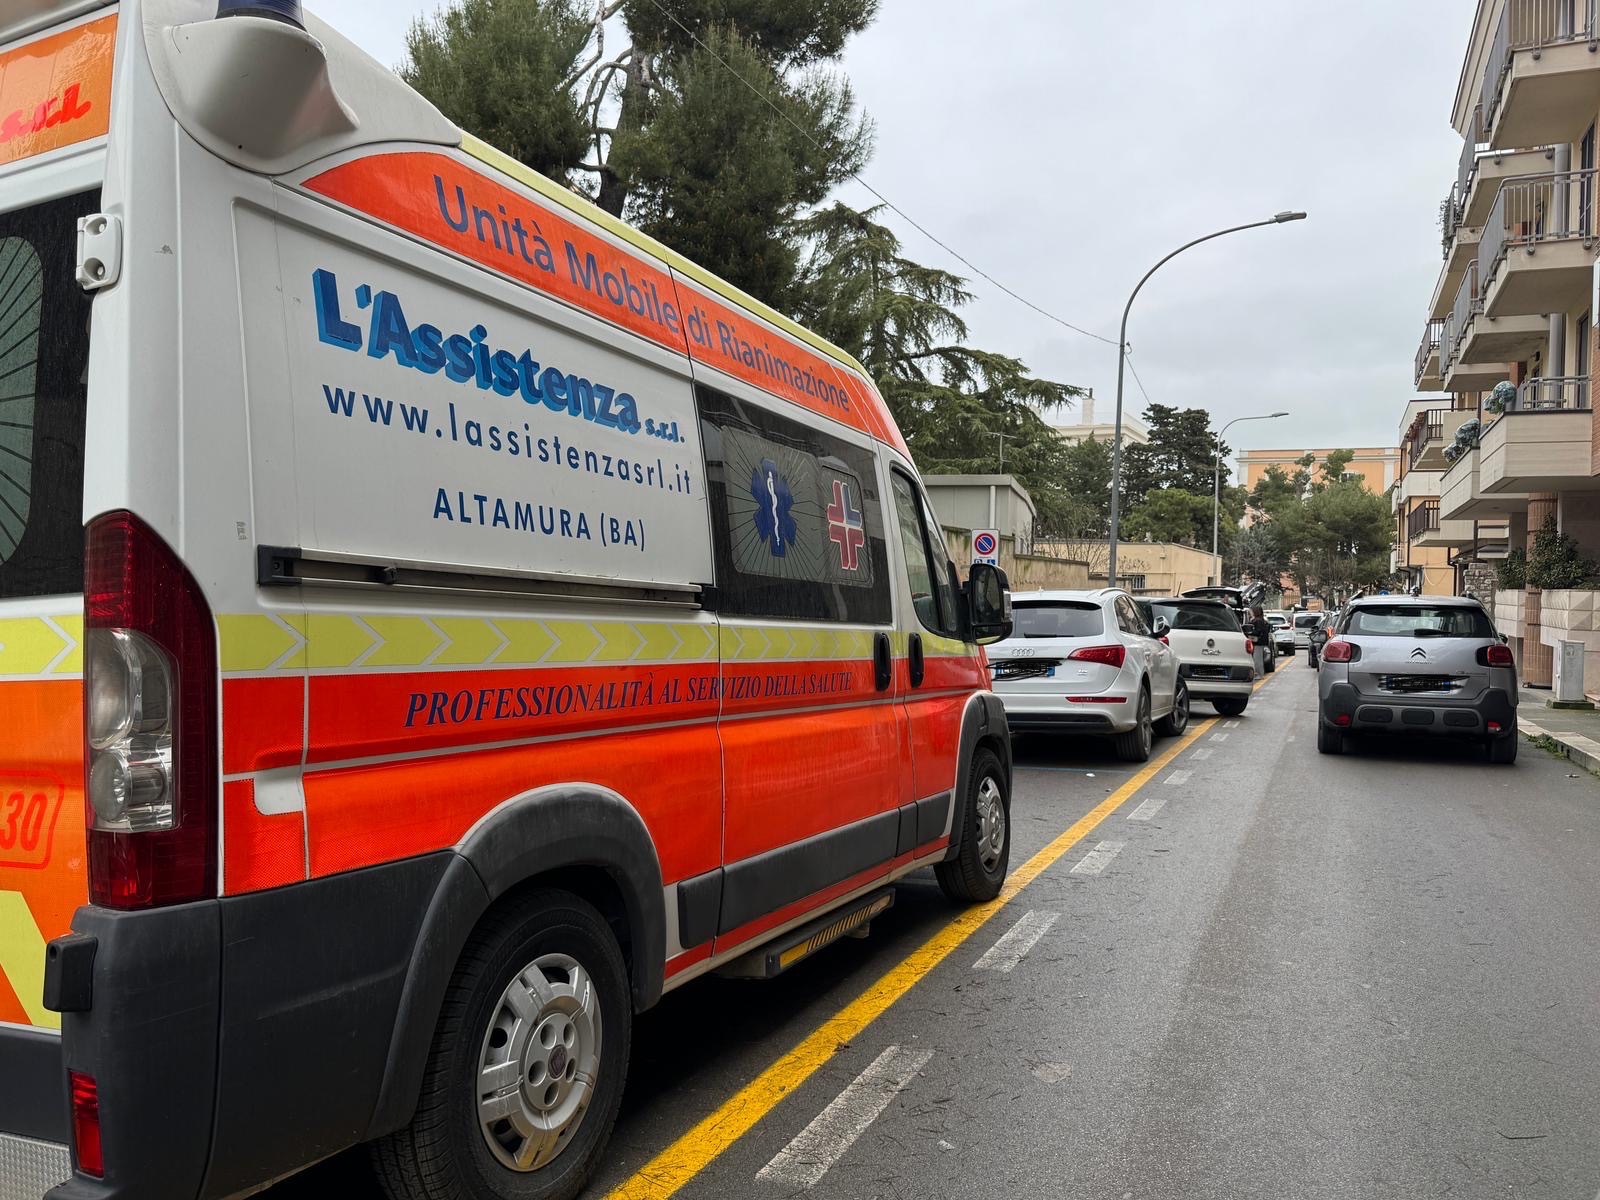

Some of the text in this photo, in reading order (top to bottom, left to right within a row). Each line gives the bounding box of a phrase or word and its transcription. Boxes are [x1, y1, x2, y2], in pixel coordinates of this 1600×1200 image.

[433, 174, 850, 412] Unità Mobile di Rianimazione
[312, 268, 685, 443] L'Assistenza s.r.l.
[322, 384, 691, 494] www.lassistenzasrl.it
[433, 488, 646, 552] ALTAMURA (BA)
[402, 671, 852, 728] PROFESSIONALITÀ AL SERVIZIO DELLA SALUTE
[0, 791, 48, 851] 30
